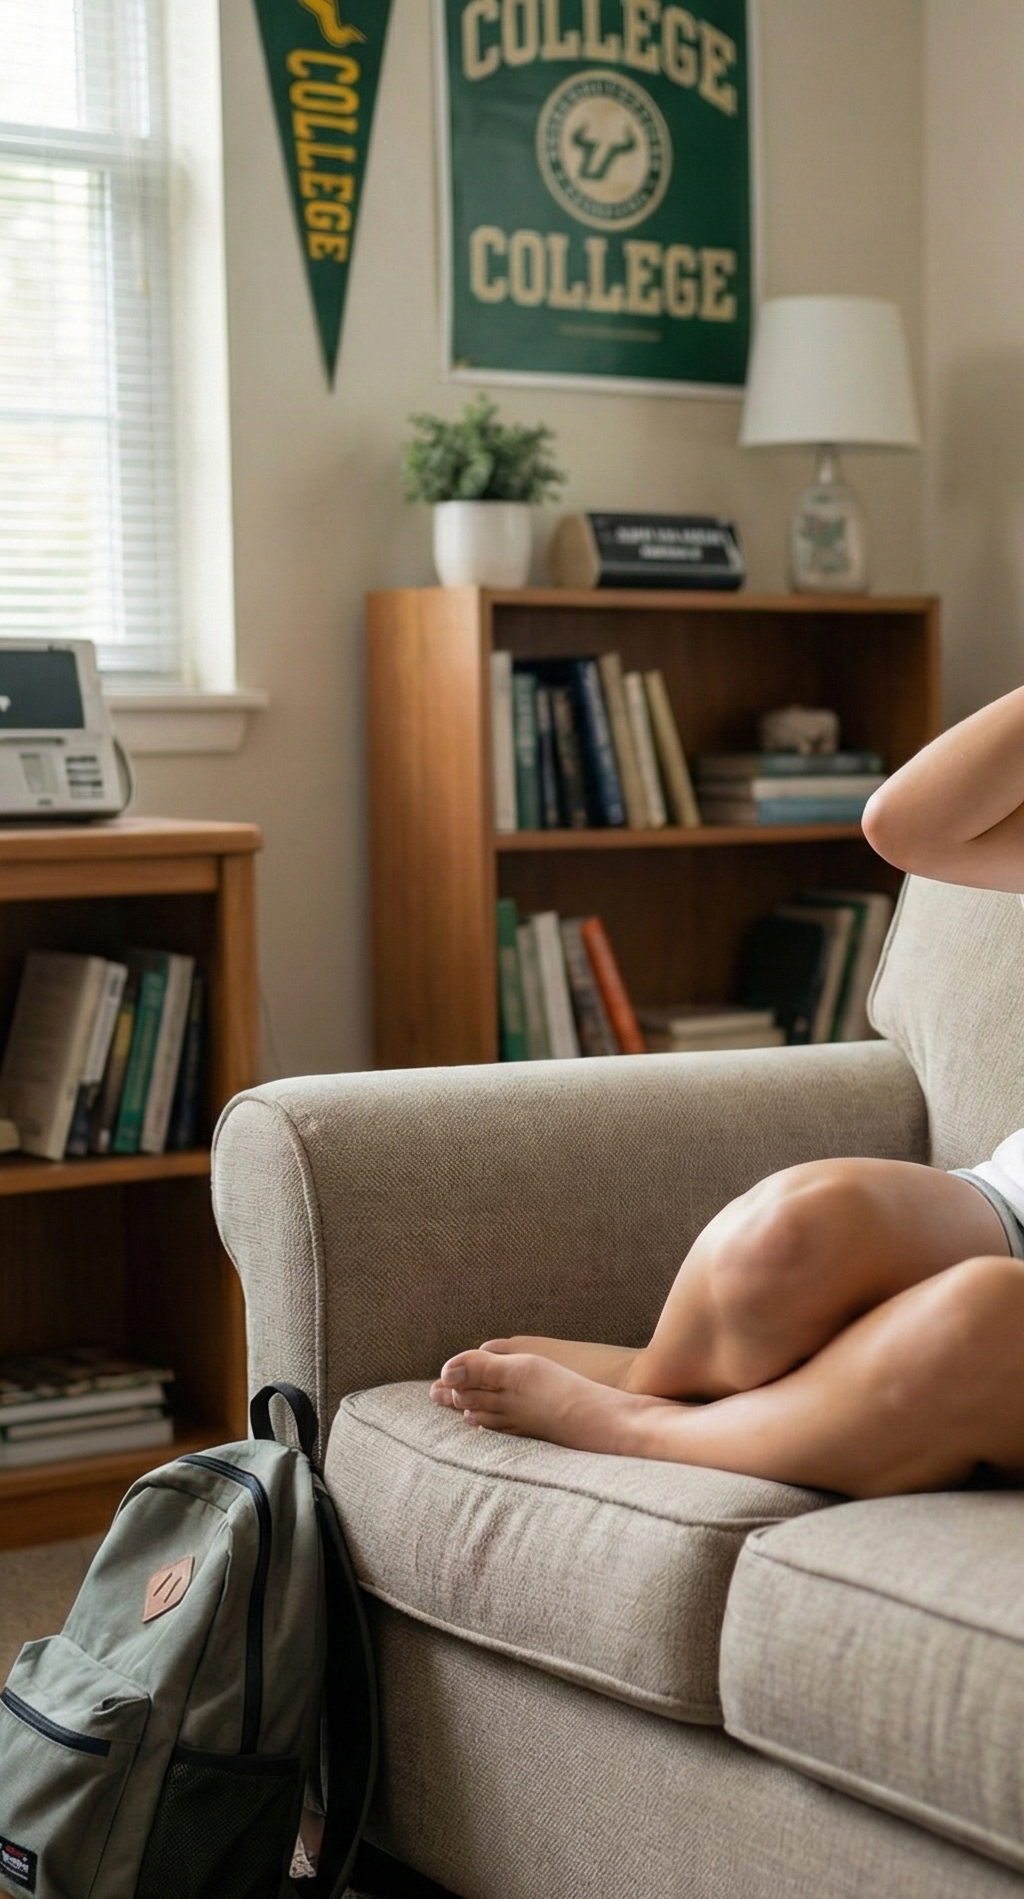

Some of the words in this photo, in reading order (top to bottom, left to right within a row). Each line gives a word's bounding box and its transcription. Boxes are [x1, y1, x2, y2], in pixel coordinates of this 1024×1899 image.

[463, 0, 737, 115] COLLEGE
[286, 49, 361, 264] COLLEGE
[469, 224, 737, 322] COLLEGE
